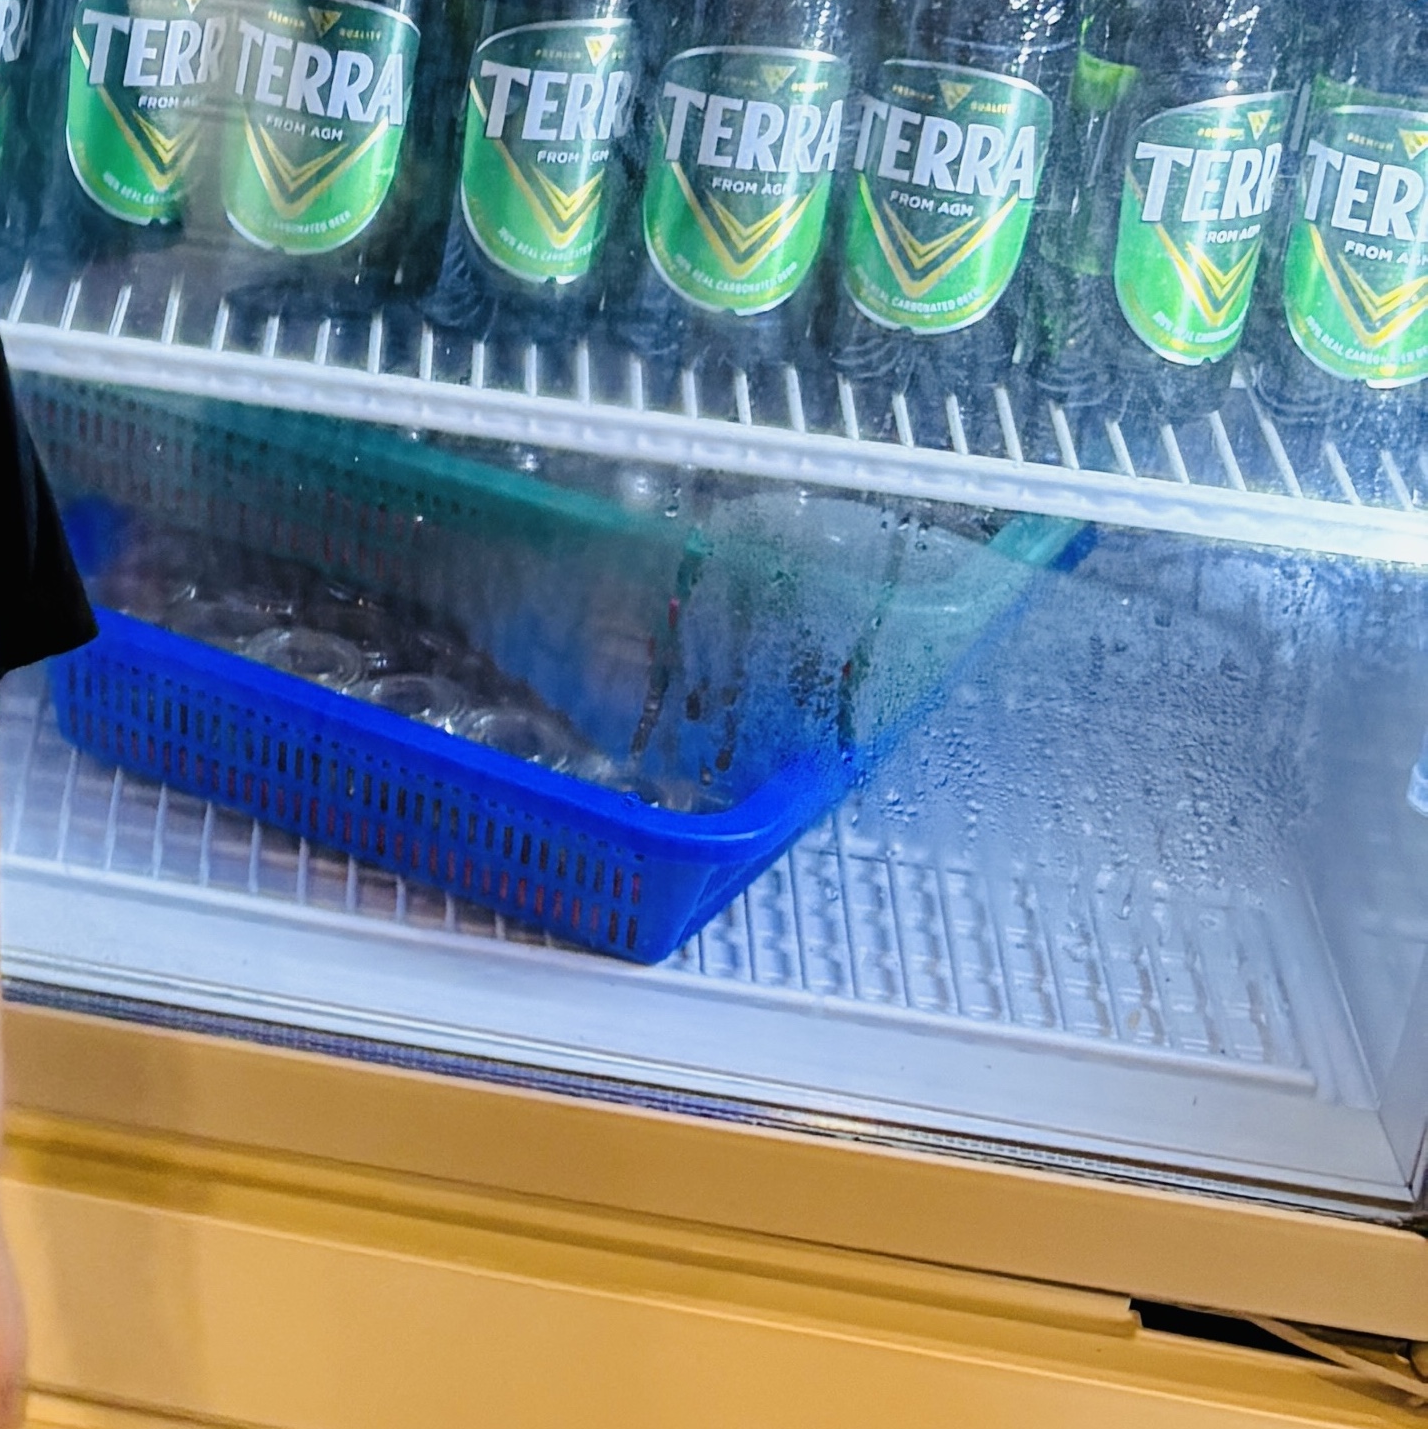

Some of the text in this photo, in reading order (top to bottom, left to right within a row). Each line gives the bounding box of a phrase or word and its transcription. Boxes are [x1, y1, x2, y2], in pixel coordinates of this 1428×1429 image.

[82, 8, 227, 89] TERR
[234, 18, 404, 126] TERRA
[265, 113, 344, 142] FROM AGM
[480, 59, 631, 141] TERR
[663, 82, 844, 174] TERRA
[536, 148, 580, 165] FROM
[712, 177, 758, 195] FROM
[853, 95, 1036, 200] TERRA
[1135, 141, 1283, 223] TERR
[889, 190, 974, 218] FROM AGM
[1304, 138, 1428, 243] TER
[1344, 239, 1393, 264] FROM
